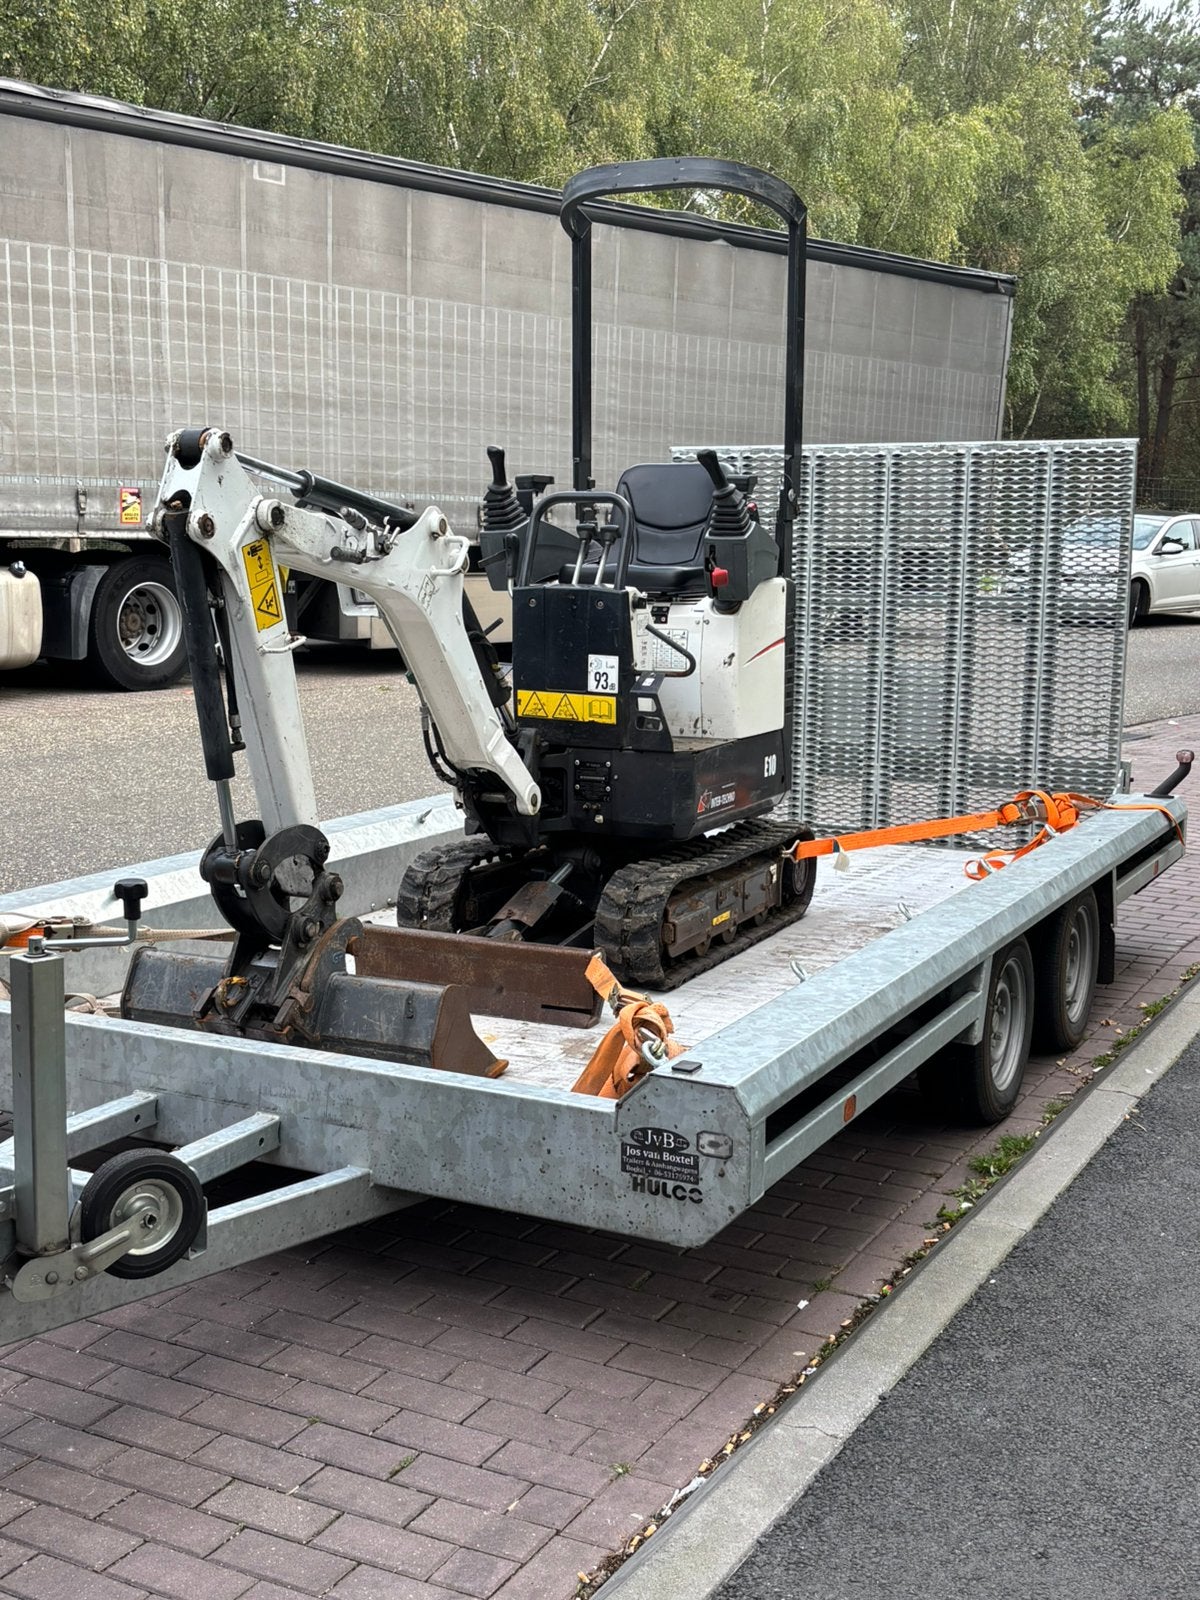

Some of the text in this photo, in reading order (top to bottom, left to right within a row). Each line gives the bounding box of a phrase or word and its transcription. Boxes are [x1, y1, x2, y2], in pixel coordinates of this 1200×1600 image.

[594, 671, 609, 690] 93
[764, 753, 777, 778] E10
[644, 1129, 675, 1149] JvB
[625, 1145, 694, 1166] Jos van Boxtel
